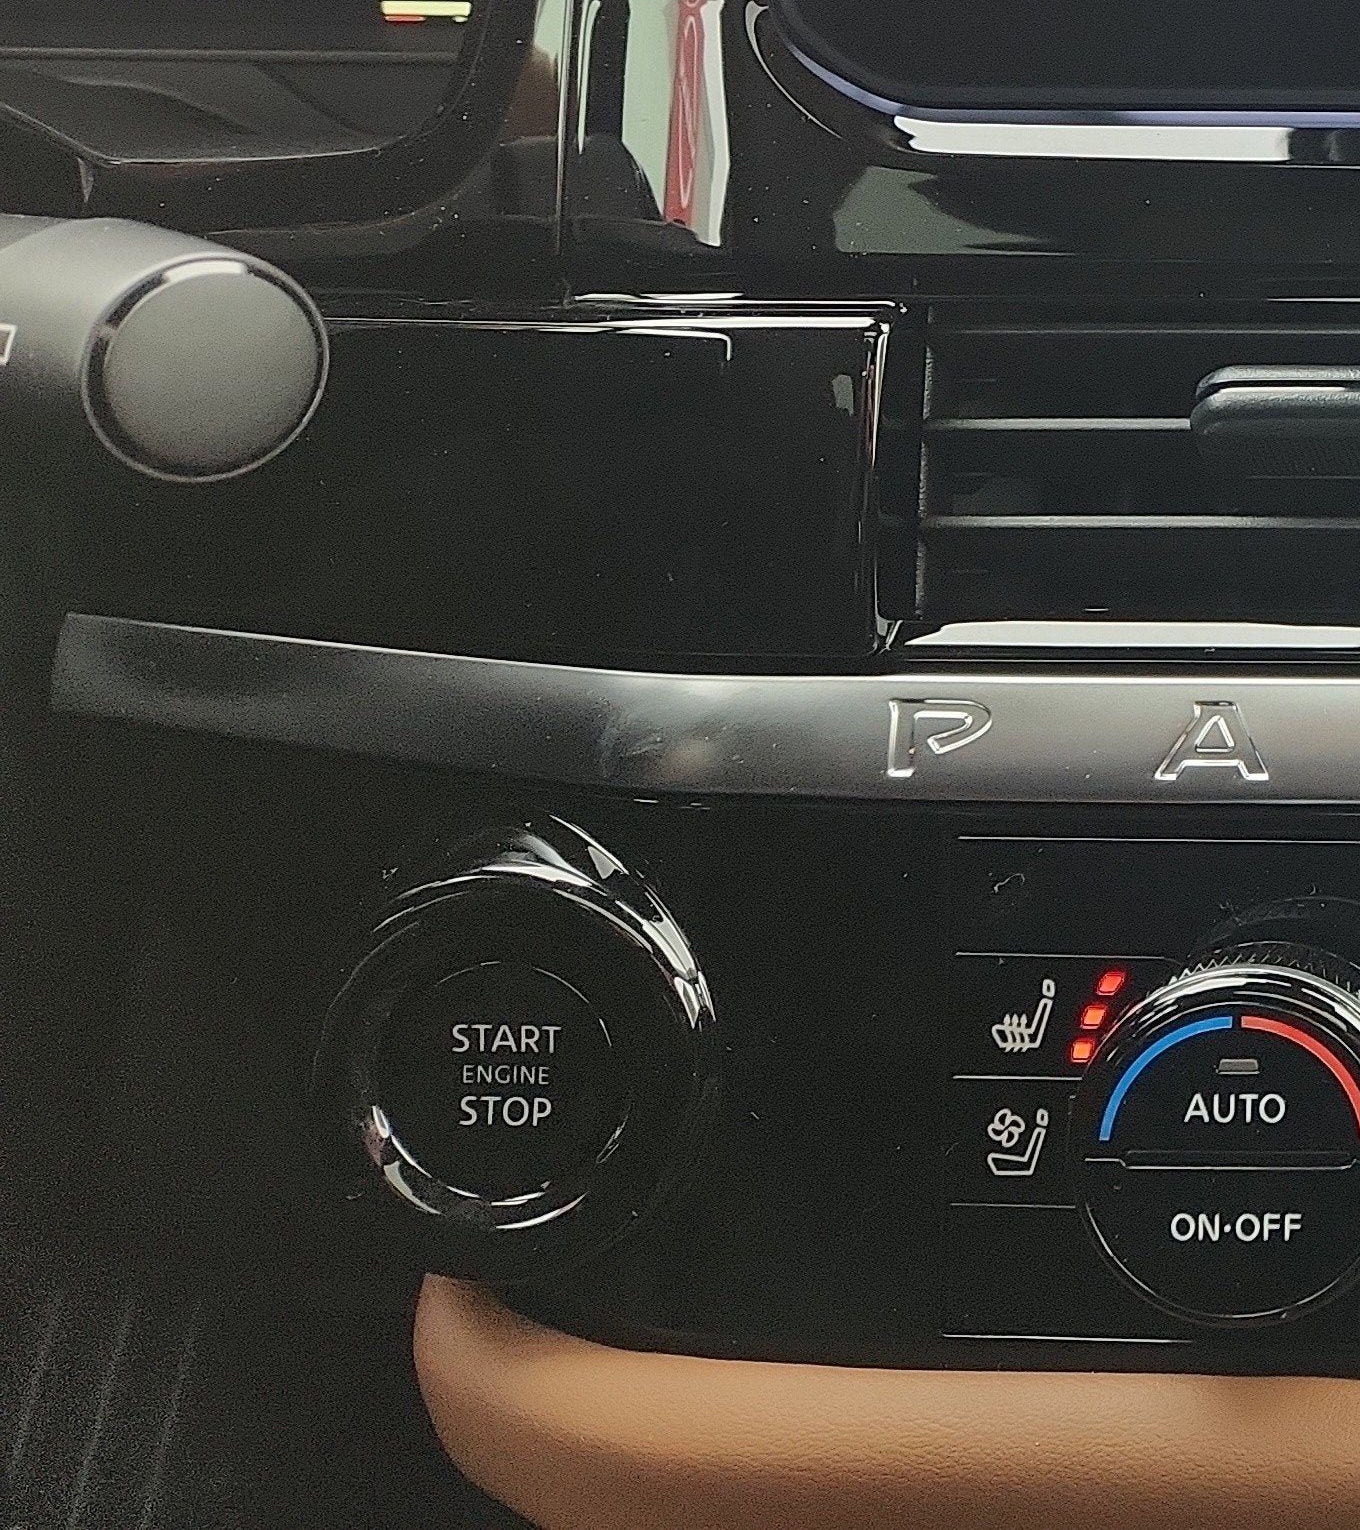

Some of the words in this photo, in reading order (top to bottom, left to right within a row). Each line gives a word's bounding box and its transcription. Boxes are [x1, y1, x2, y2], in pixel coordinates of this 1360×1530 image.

[452, 1023, 562, 1054] START
[462, 1064, 550, 1085] ENGINE
[459, 1095, 552, 1127] STOP
[1184, 1093, 1286, 1124] AUTO
